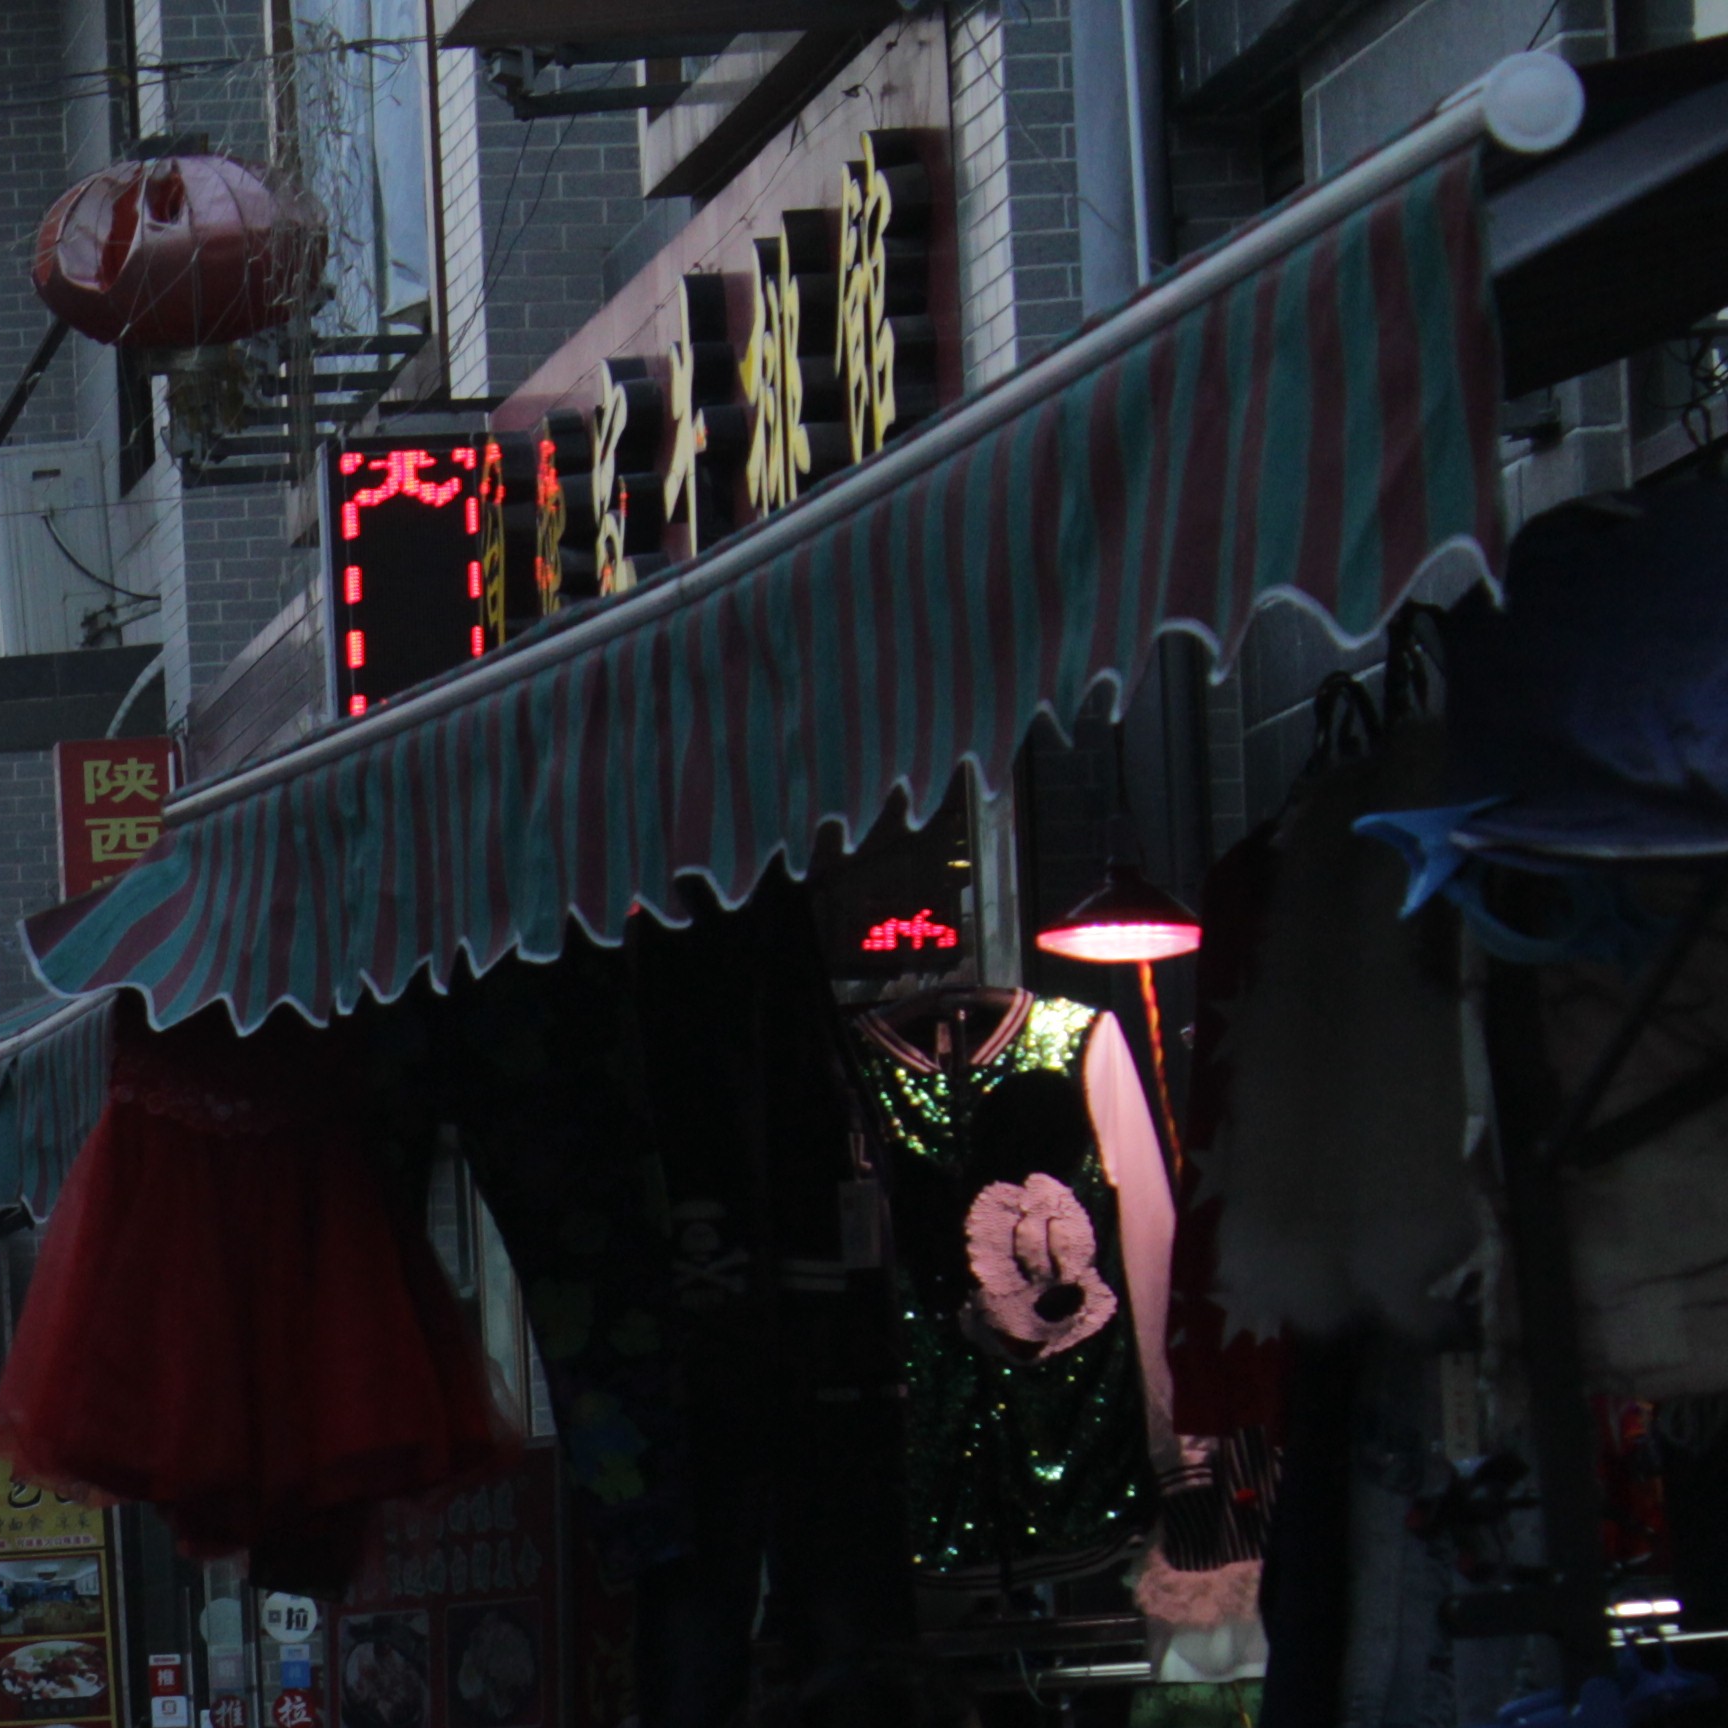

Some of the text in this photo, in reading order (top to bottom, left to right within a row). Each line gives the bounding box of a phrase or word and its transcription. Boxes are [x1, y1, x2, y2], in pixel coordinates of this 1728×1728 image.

[83, 757, 162, 890] 陕西
[157, 1668, 175, 1687] 推
[277, 1695, 312, 1728] 拉
